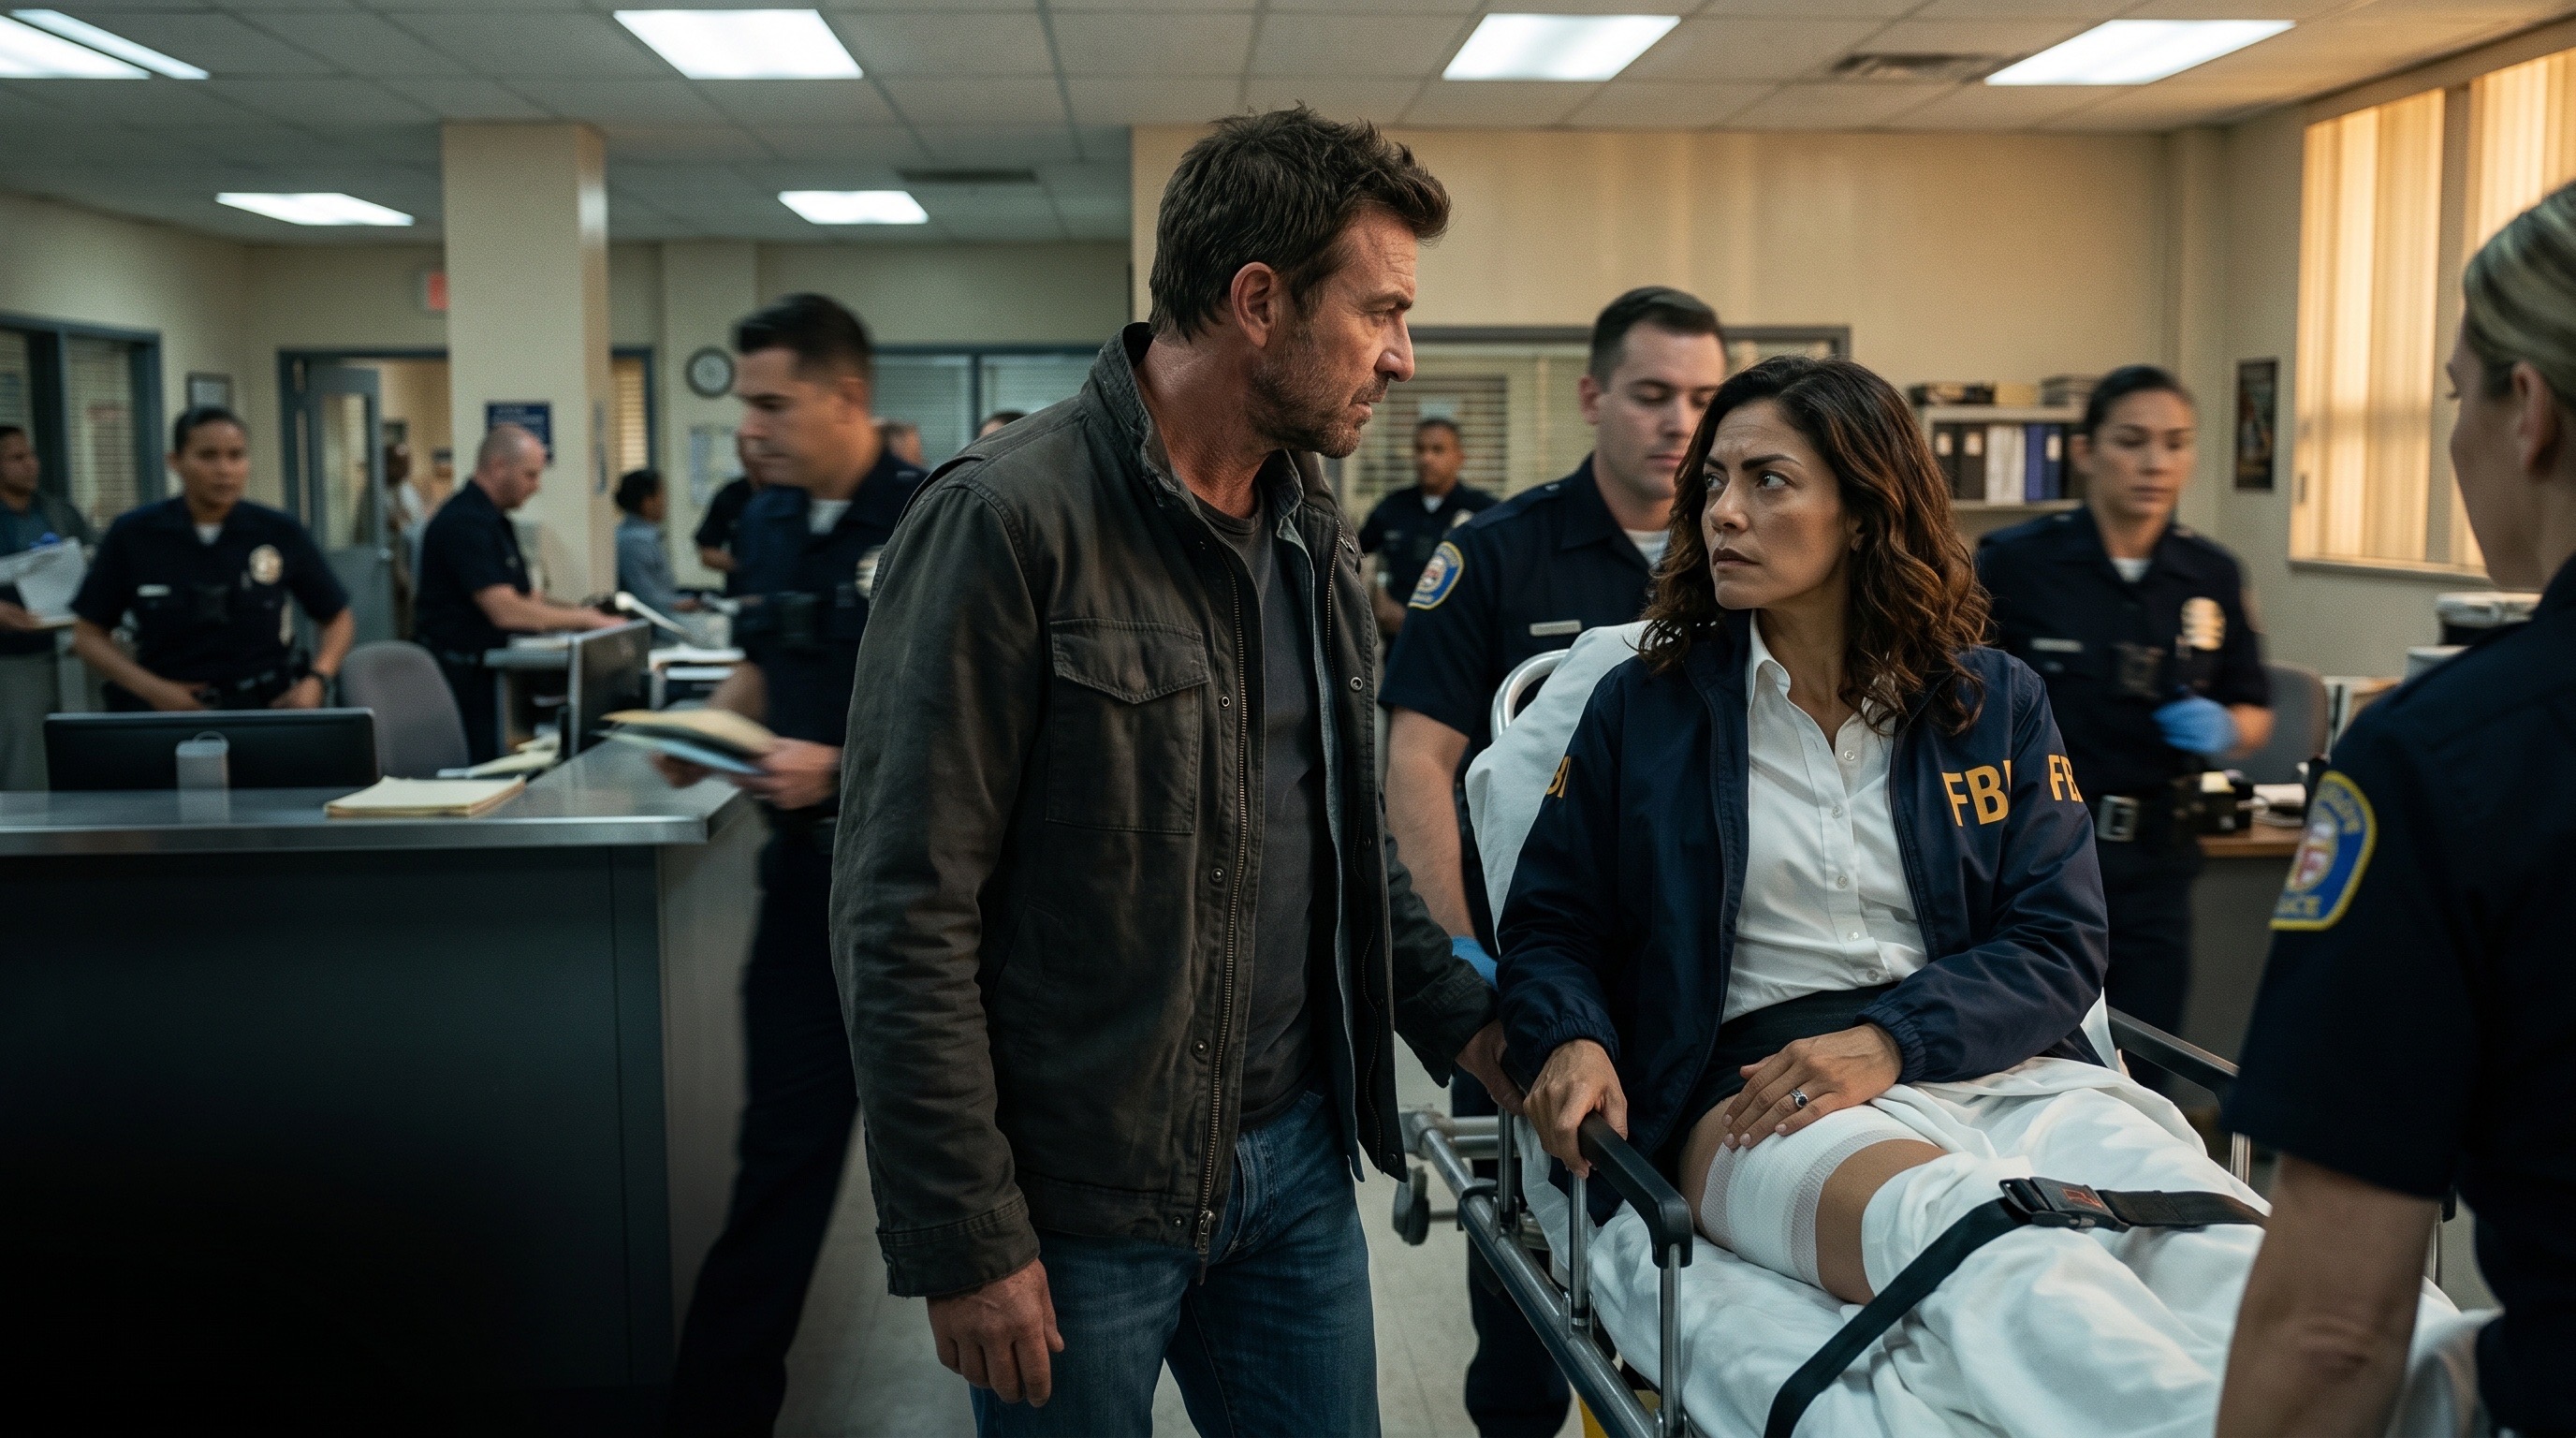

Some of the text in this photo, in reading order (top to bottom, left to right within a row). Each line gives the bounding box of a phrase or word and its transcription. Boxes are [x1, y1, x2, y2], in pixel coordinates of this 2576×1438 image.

[1546, 756, 1572, 799] BI
[1941, 759, 2012, 828] FB
[2048, 755, 2084, 803] FB
